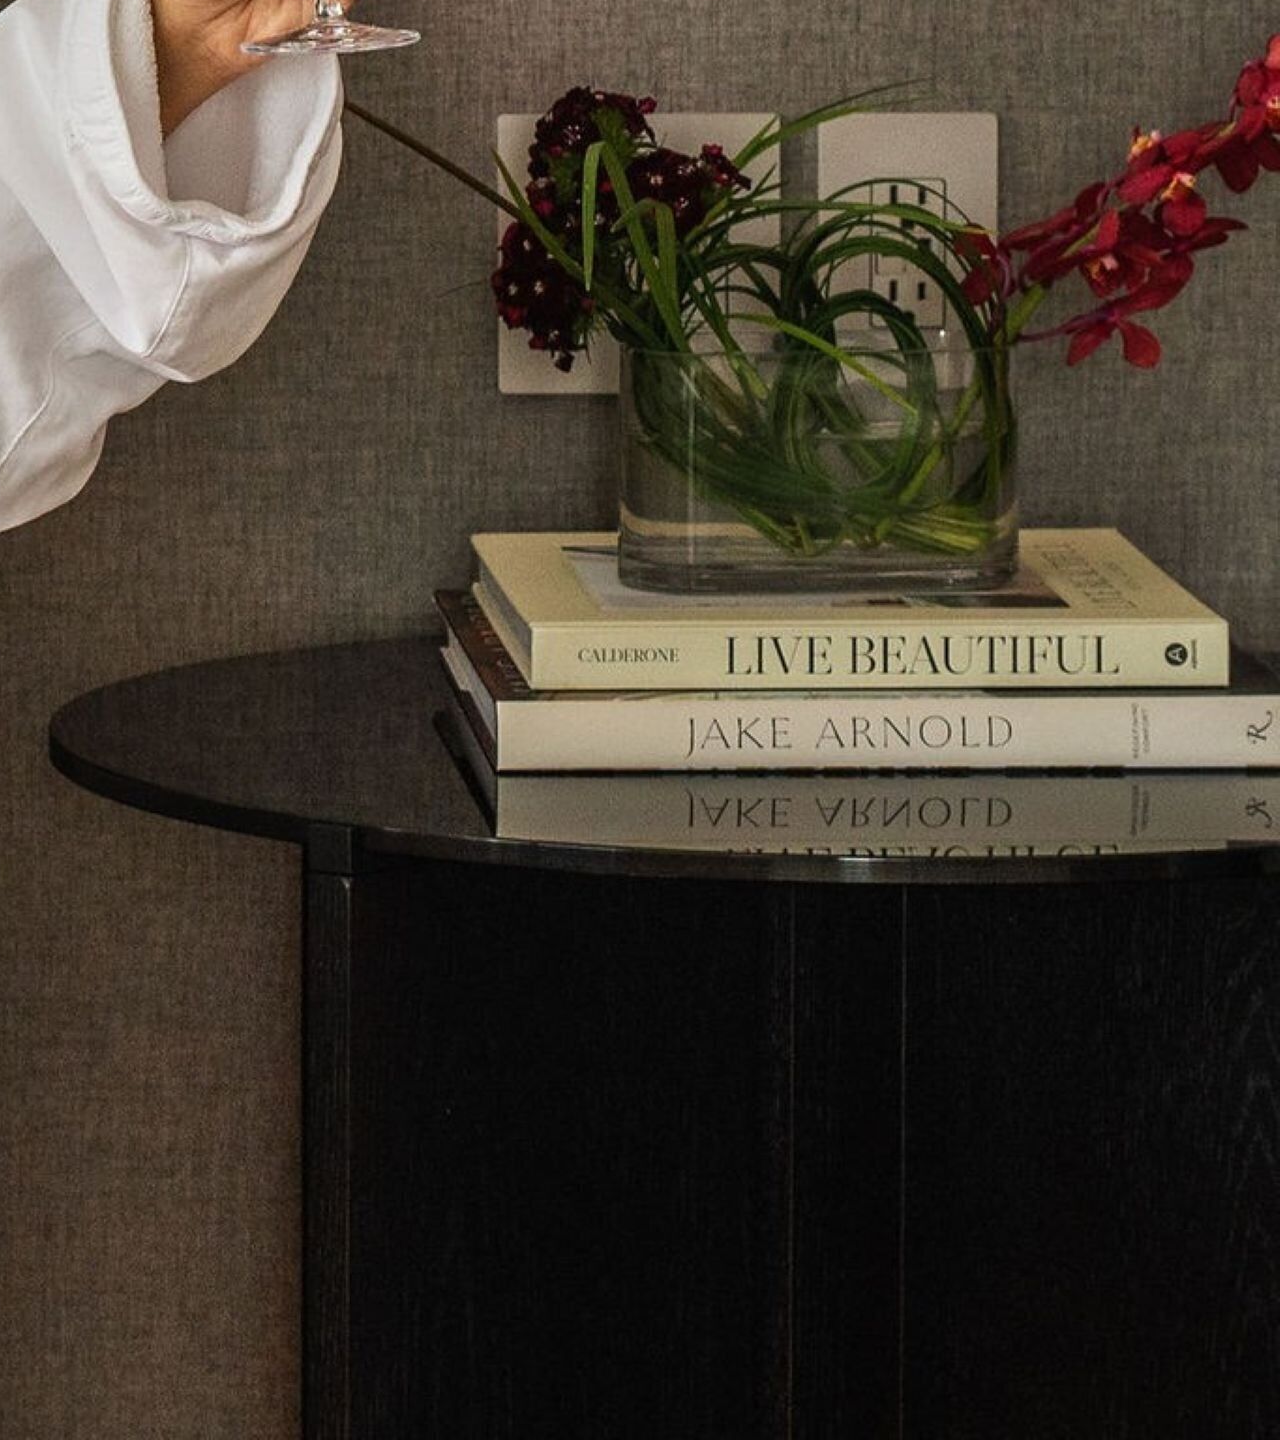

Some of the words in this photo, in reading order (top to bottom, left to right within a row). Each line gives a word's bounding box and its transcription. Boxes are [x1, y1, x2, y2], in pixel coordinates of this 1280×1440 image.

[578, 648, 679, 662] CALDERONE
[728, 637, 832, 674] LIVE
[852, 636, 1119, 674] BEAUTIFUL
[686, 717, 793, 758] JAKE
[816, 716, 1012, 748] ARNOLD
